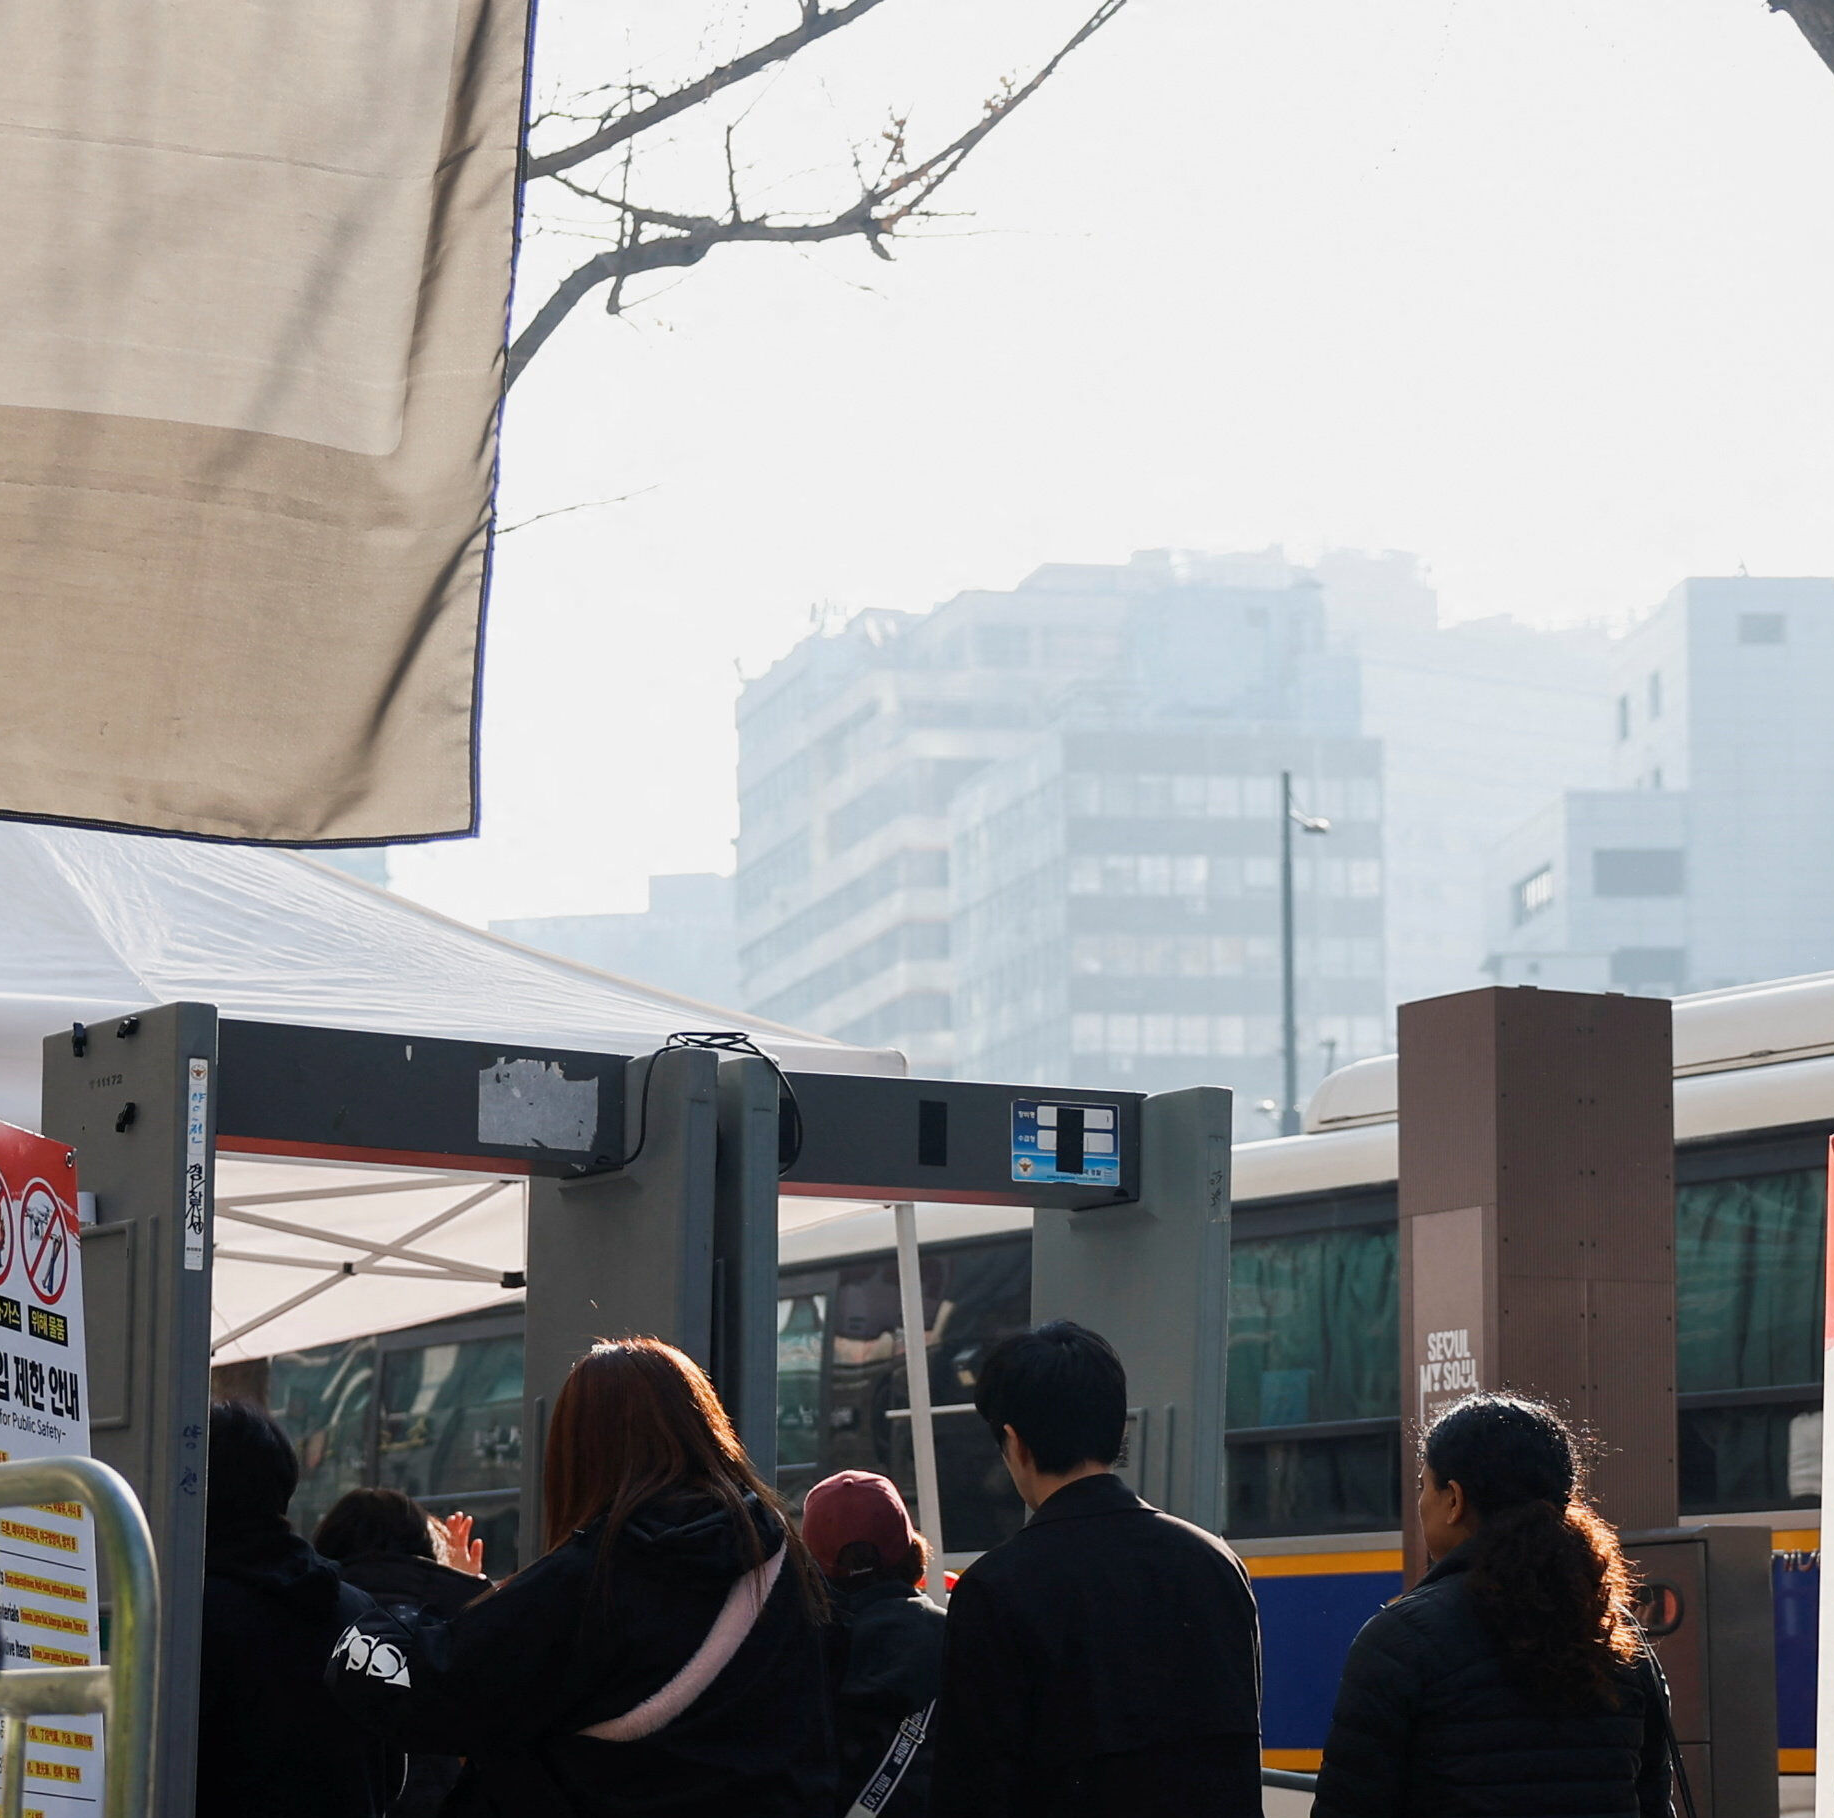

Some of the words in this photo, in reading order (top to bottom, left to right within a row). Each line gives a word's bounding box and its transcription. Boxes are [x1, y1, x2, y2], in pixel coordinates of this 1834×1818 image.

[14, 1355, 45, 1412] 제한
[49, 1366, 79, 1421] 안내
[0, 1409, 11, 1424] for
[12, 1413, 36, 1434] Public
